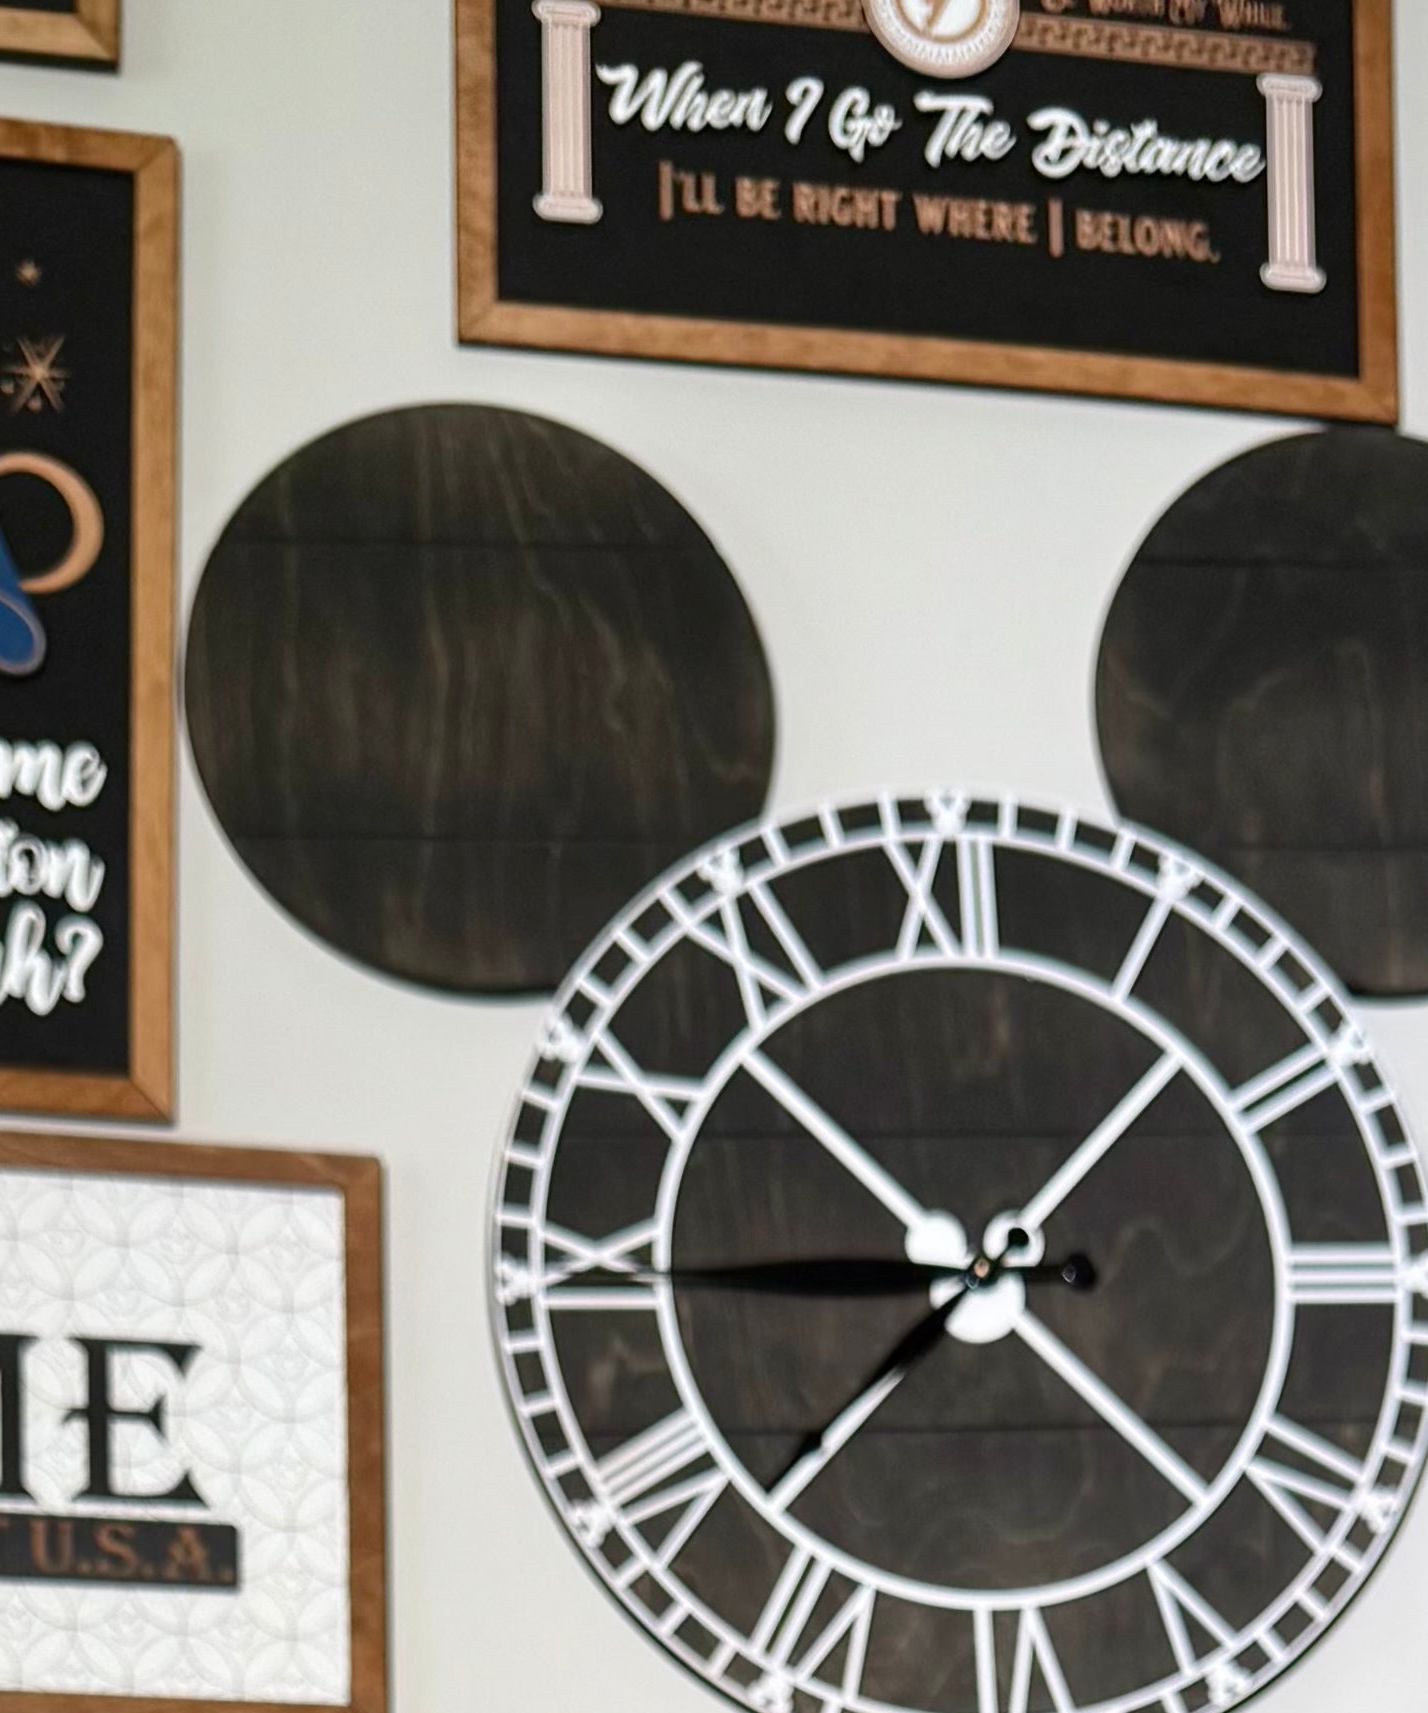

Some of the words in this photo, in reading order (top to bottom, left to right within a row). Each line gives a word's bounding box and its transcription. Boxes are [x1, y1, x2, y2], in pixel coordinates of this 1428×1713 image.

[596, 61, 770, 133] When
[784, 78, 824, 143] I
[829, 88, 902, 164] Go
[915, 91, 1015, 166] The
[1029, 105, 1265, 183] Distance
[657, 160, 725, 219] I'LL
[736, 171, 782, 221] BE
[793, 181, 899, 232] RIGHT
[909, 191, 1035, 244] WHERE
[1048, 200, 1065, 258] I
[1075, 210, 1221, 263] BELONG.
[27, 1519, 237, 1586] U.S.A.
